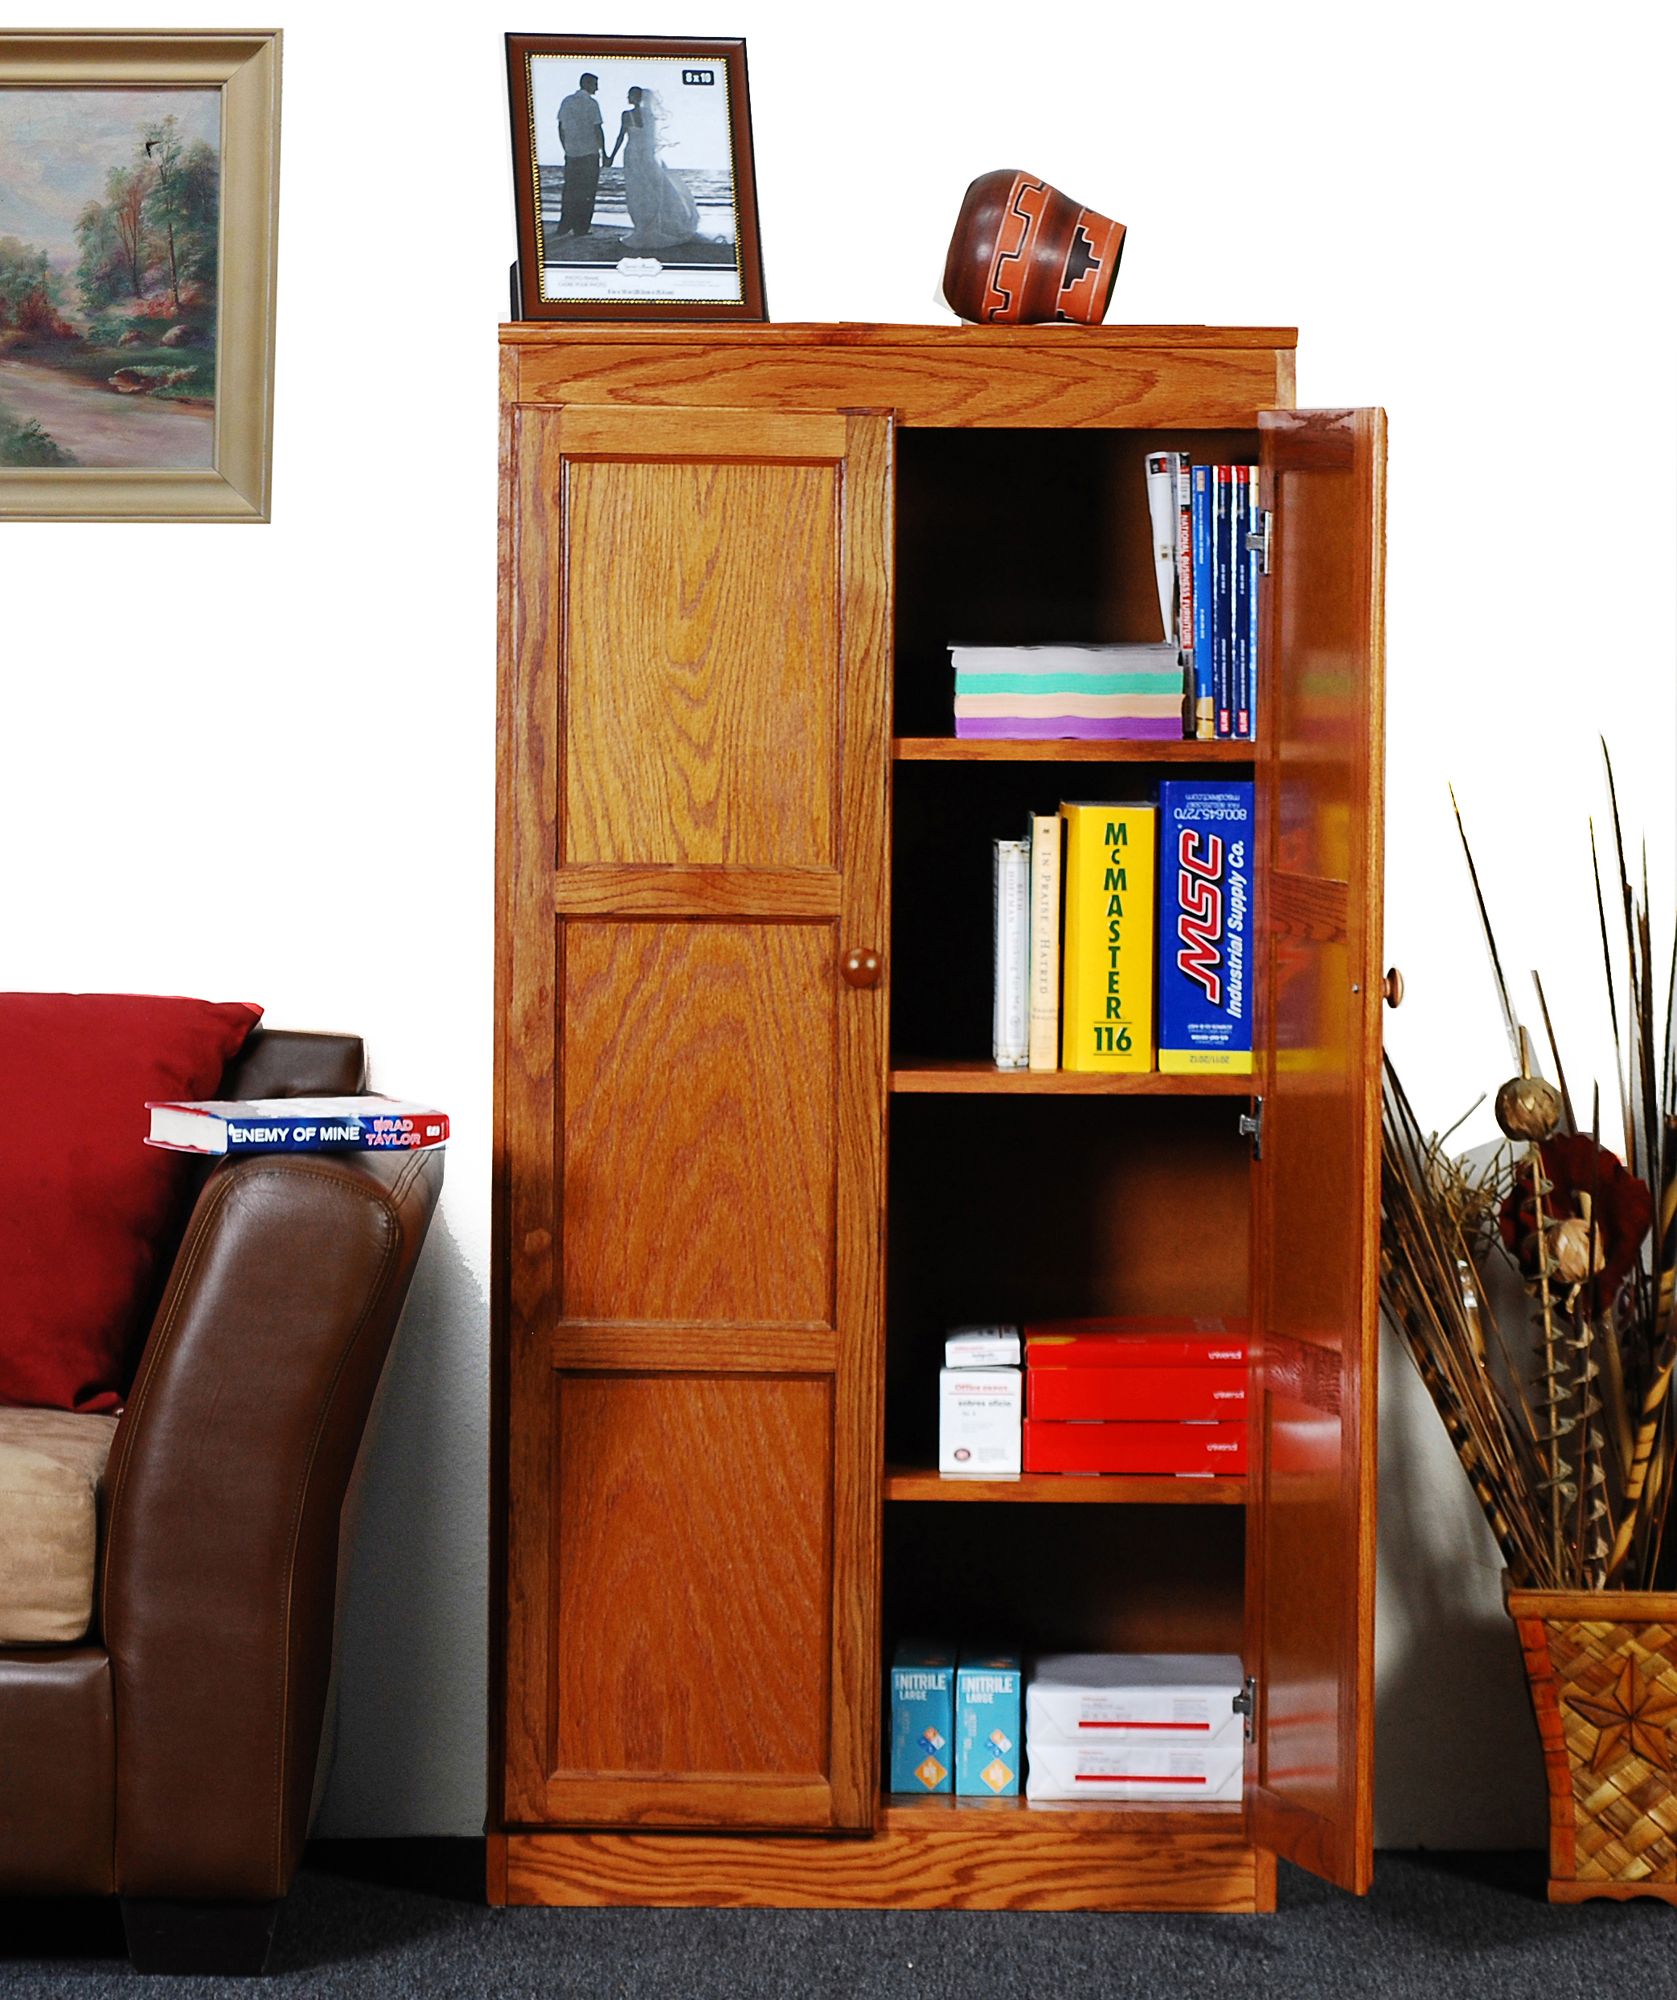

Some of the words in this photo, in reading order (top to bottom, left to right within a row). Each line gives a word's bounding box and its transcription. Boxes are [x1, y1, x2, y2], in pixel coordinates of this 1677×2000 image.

[1174, 808, 1248, 820] 800.645.7270
[1228, 840, 1245, 868] Co.
[1227, 870, 1247, 932] Supply
[1177, 828, 1222, 1005] MSC
[1226, 932, 1244, 1019] Industrial
[1094, 1027, 1132, 1052] 116
[373, 1117, 413, 1132] BRAD
[231, 1127, 290, 1143] ENEMY
[292, 1127, 316, 1142] OF
[319, 1126, 360, 1141] MINE
[365, 1132, 421, 1146] TAYLOR
[900, 1673, 946, 1690] NITRILE
[965, 1676, 1013, 1693] NITRILE
[900, 1690, 927, 1701] LARGE
[966, 1693, 994, 1704] LARGE
